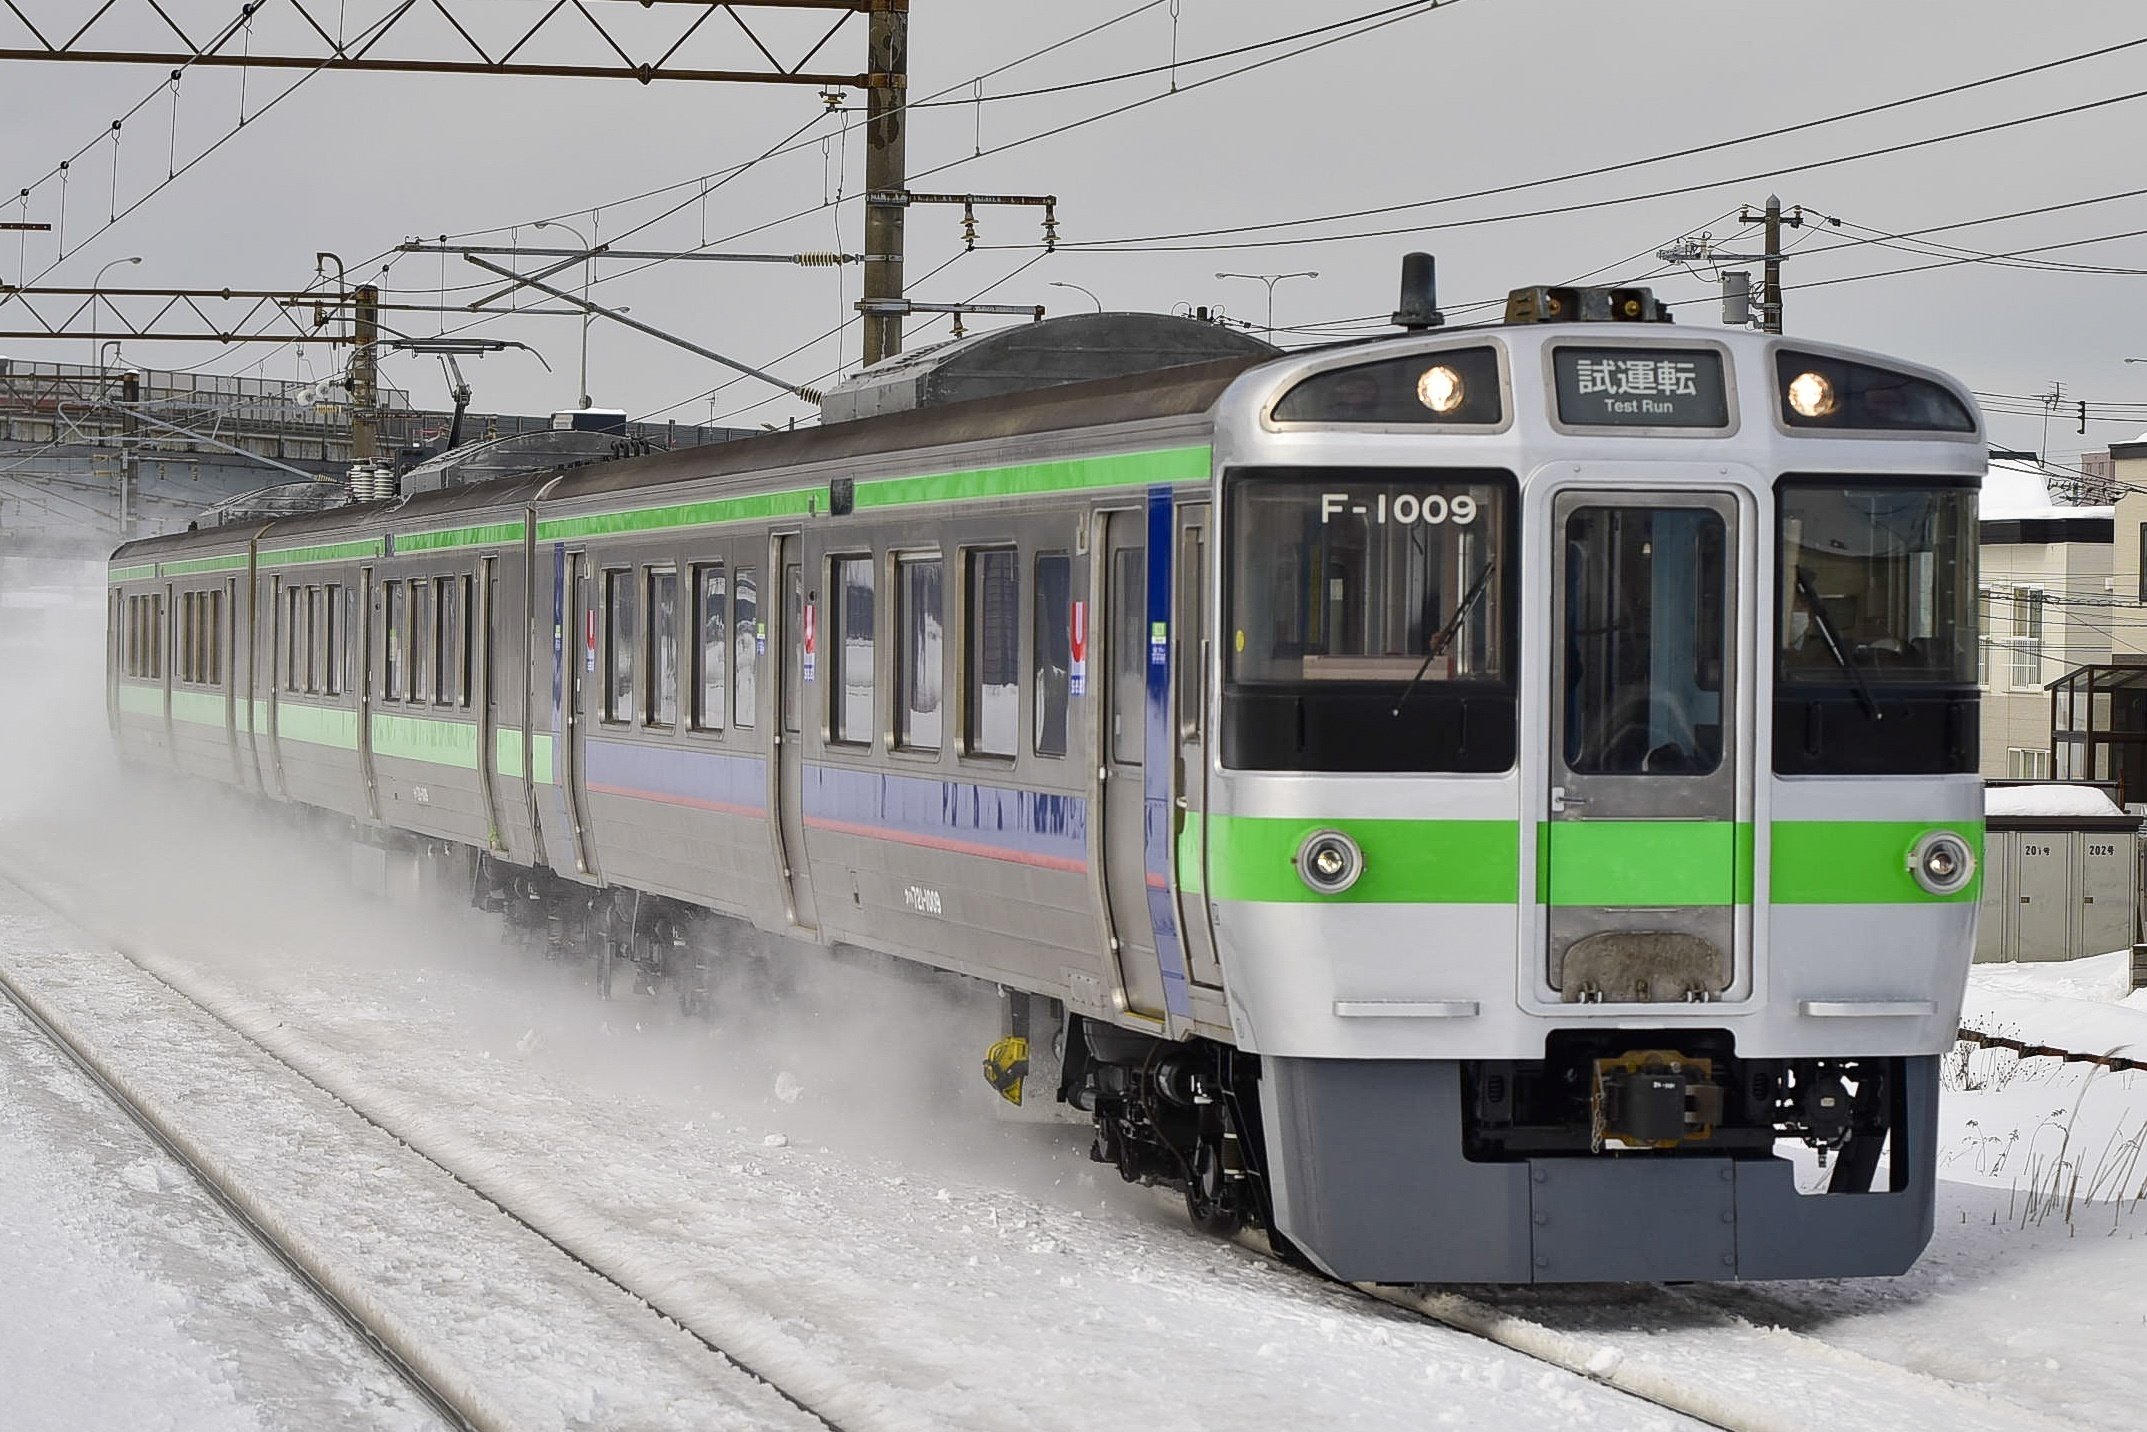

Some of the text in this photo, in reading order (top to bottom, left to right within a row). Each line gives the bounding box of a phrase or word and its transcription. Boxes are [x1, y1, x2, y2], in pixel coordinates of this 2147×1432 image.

[1577, 359, 1697, 395] 試運転
[1604, 399, 1673, 413] Test Run
[1322, 493, 1477, 525] F-1009
